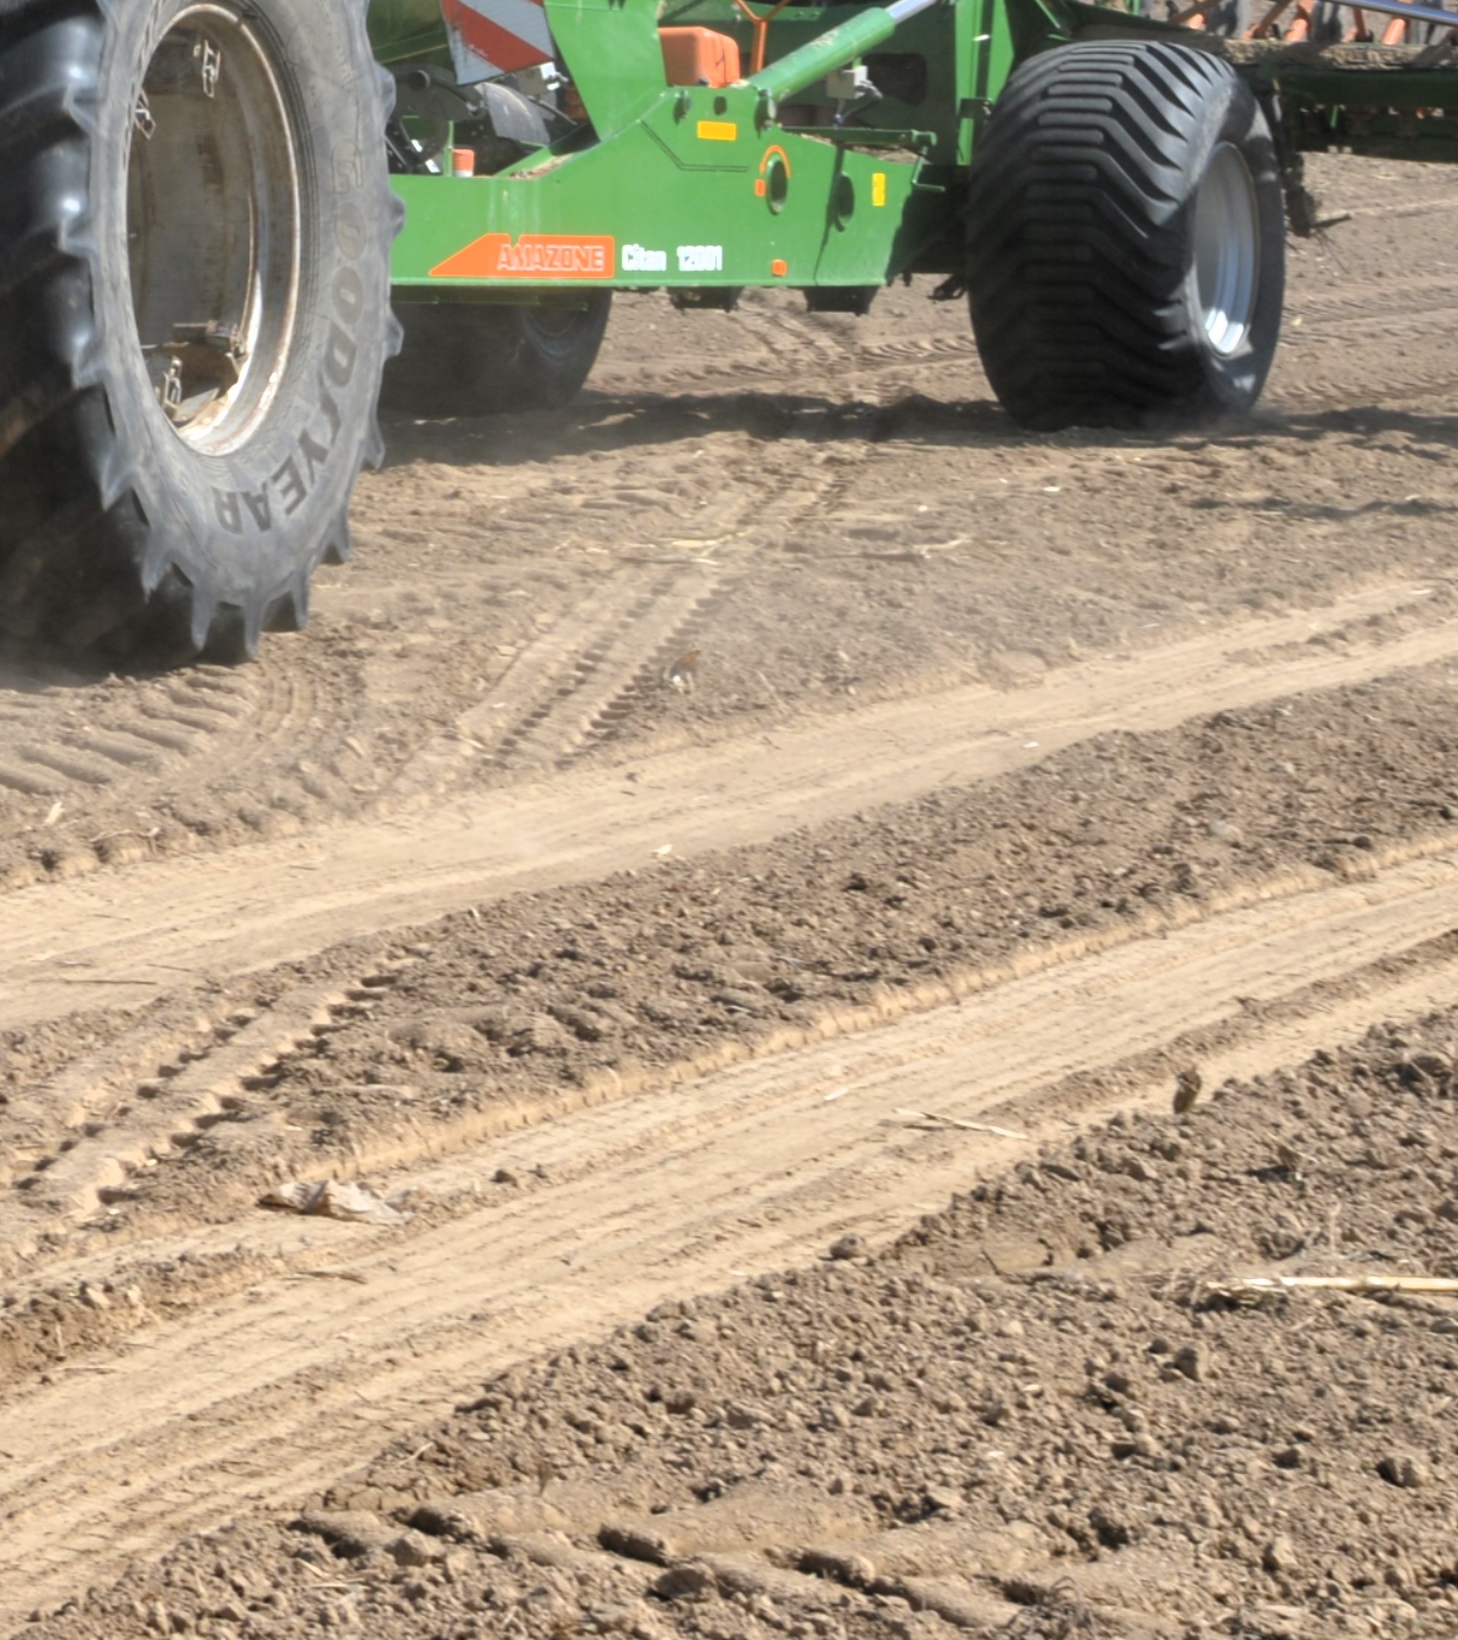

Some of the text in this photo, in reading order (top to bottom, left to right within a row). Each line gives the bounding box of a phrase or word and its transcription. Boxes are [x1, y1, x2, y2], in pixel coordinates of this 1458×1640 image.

[496, 242, 606, 272] AMAZONE
[621, 242, 668, 272] Citan
[213, 137, 366, 536] GOODYEAR
